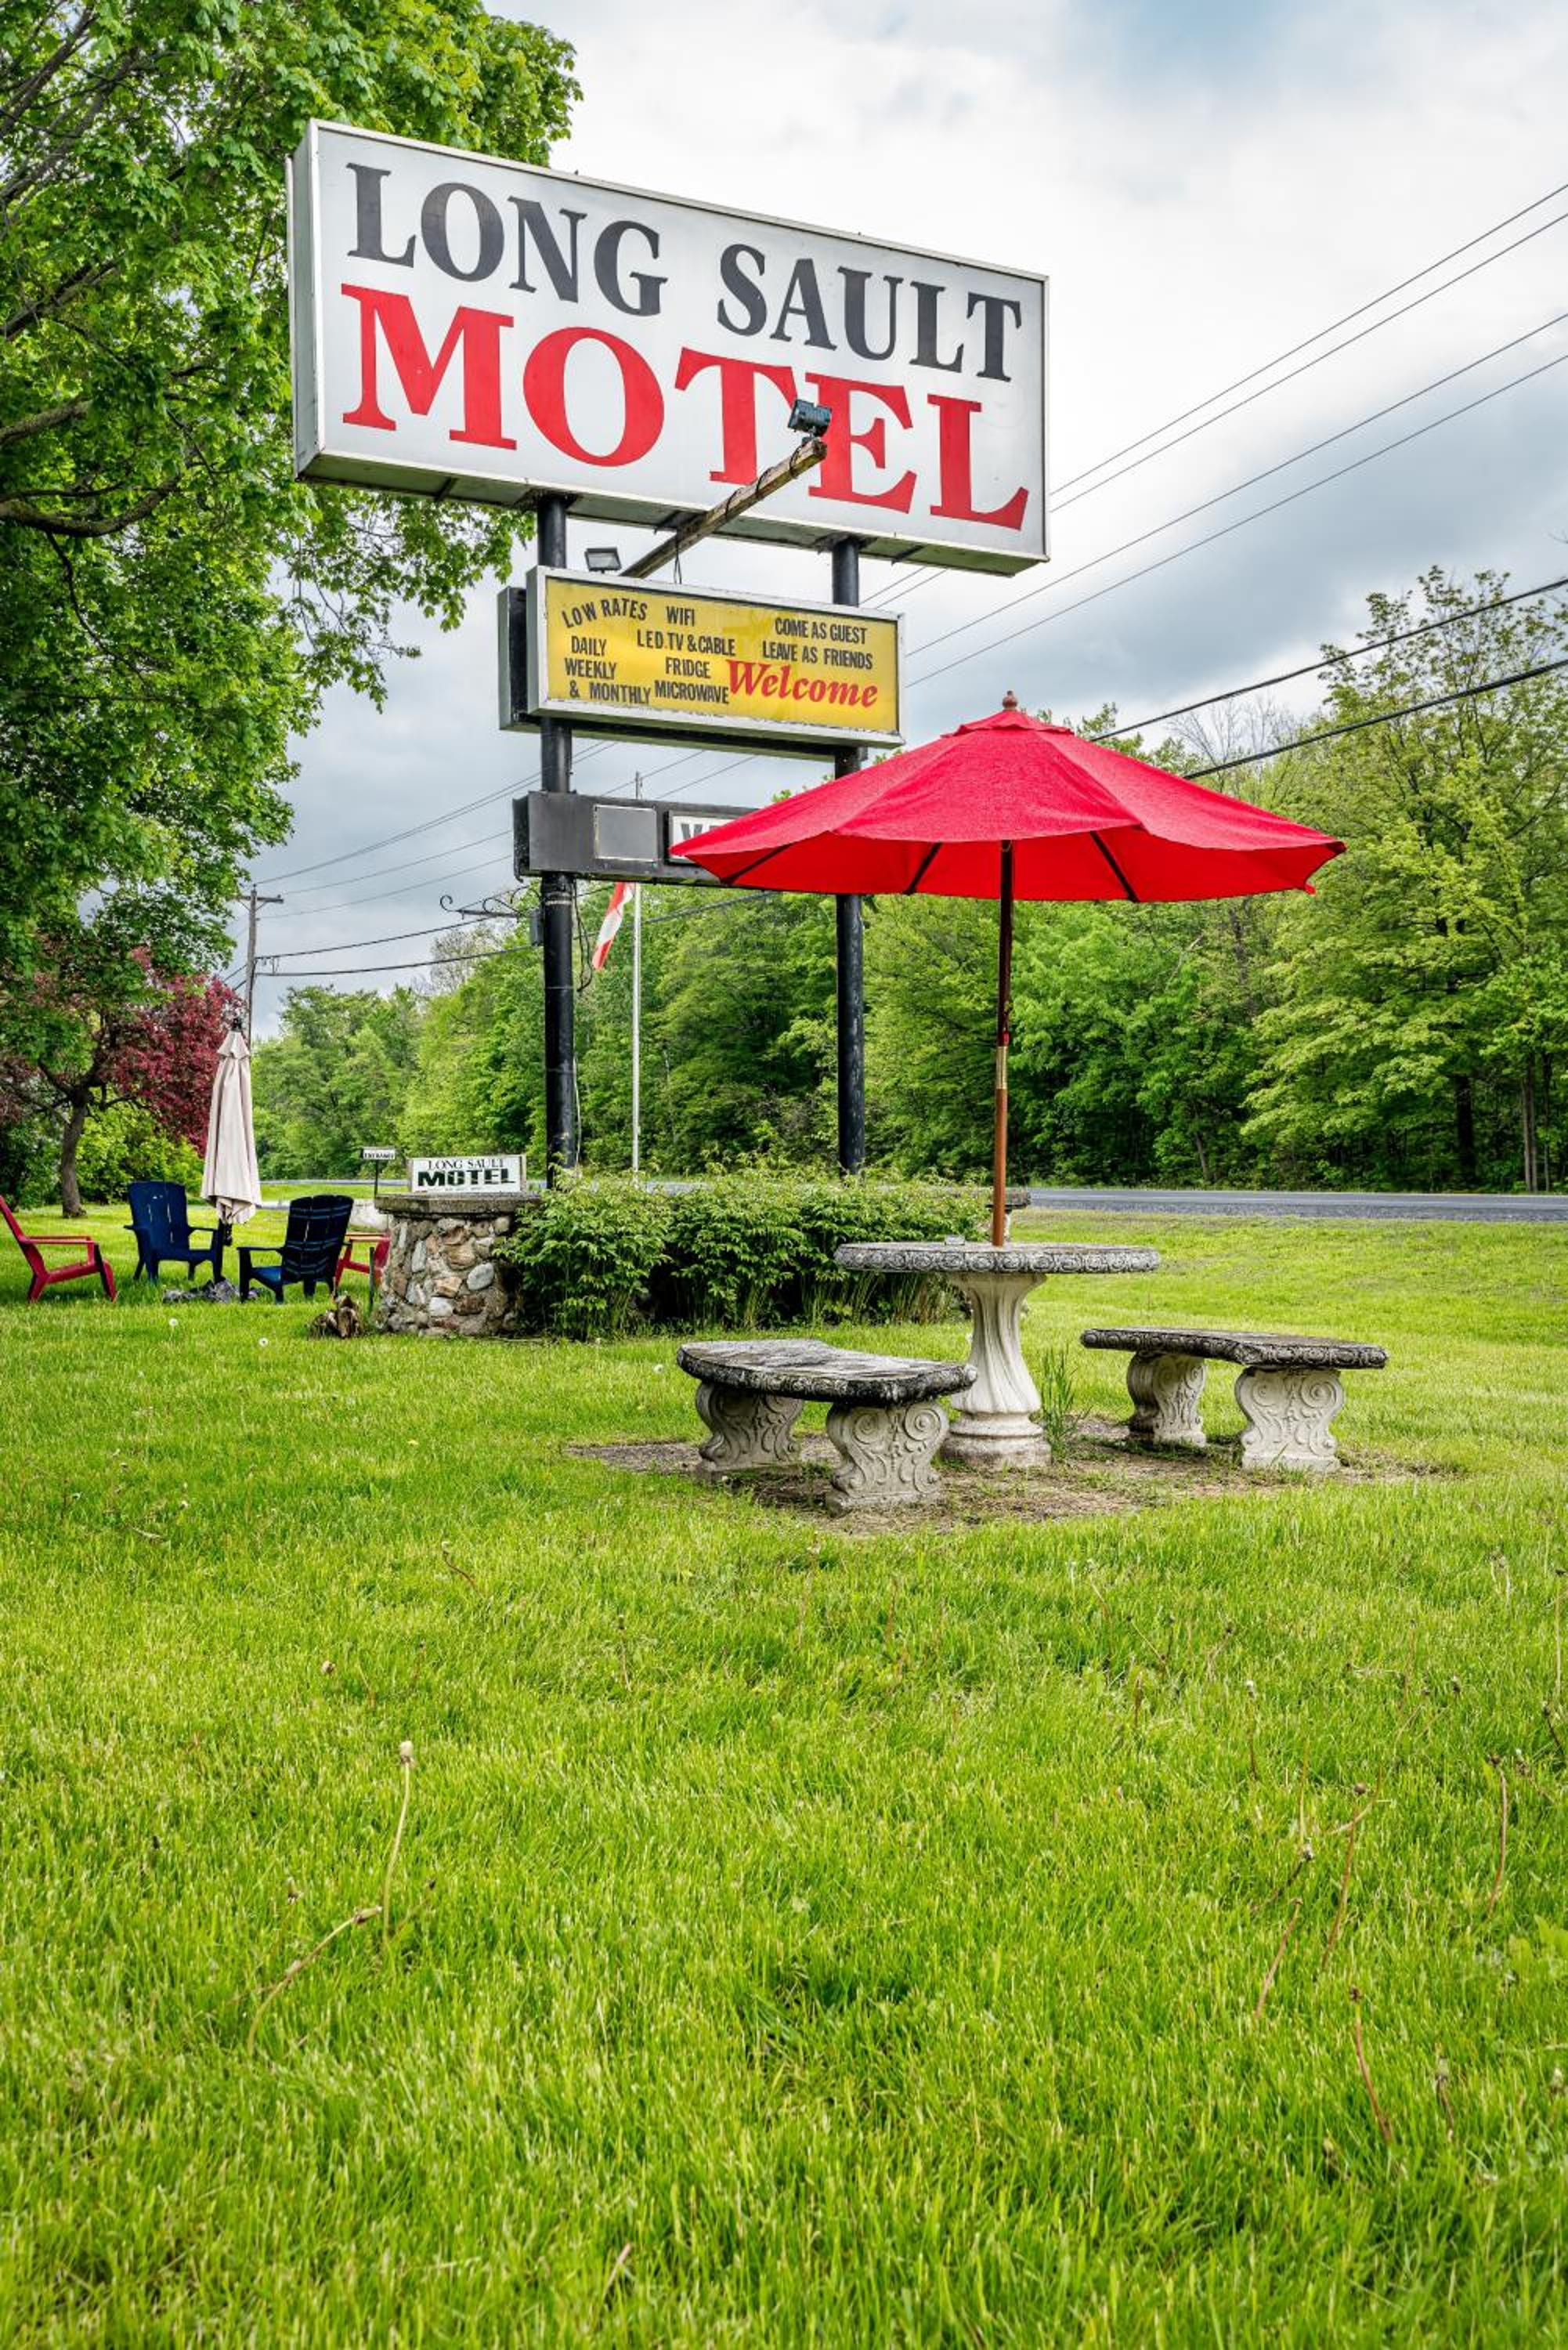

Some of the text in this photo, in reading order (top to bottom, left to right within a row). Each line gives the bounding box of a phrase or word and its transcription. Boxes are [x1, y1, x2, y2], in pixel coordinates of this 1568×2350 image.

[347, 162, 1022, 383] LONG SAULT
[341, 284, 1028, 530] MOTEL
[562, 598, 649, 627] LOW RATES
[666, 606, 695, 627] WIFI
[775, 617, 868, 645] COME AS GUEST
[571, 635, 607, 656] DAILY
[762, 641, 873, 670] LEAVE AS FRIENDS
[565, 657, 617, 679] WEEKLY
[666, 657, 711, 679] FRIDGE
[569, 680, 651, 704] & MONTHLY
[655, 680, 729, 704] MICROWAVE
[726, 660, 878, 707] Welcome
[428, 1158, 504, 1170] LONG SAULT
[417, 1168, 515, 1187] MOTEL
